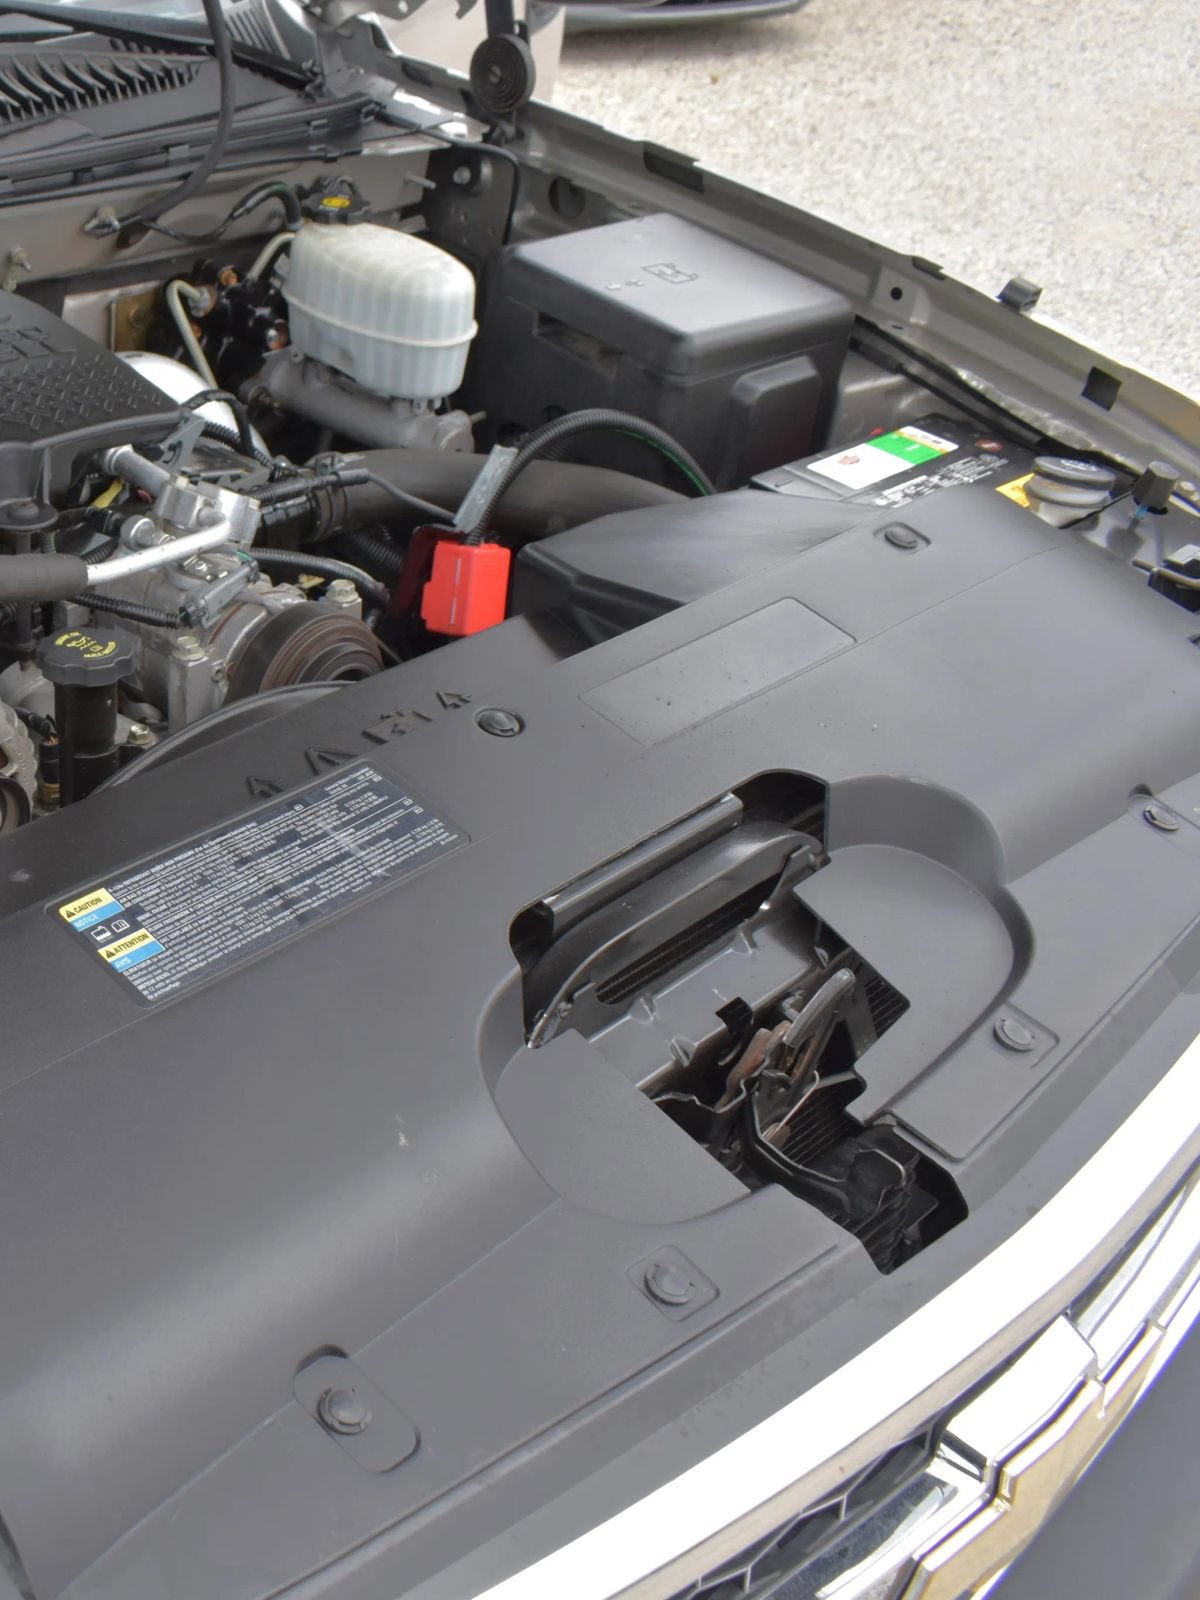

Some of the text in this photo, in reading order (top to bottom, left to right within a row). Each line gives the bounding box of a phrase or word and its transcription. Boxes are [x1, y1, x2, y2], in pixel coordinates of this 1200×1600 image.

[73, 897, 103, 914] CAUTION
[73, 913, 98, 929] NOTICE
[113, 933, 150, 955] ATTENTION
